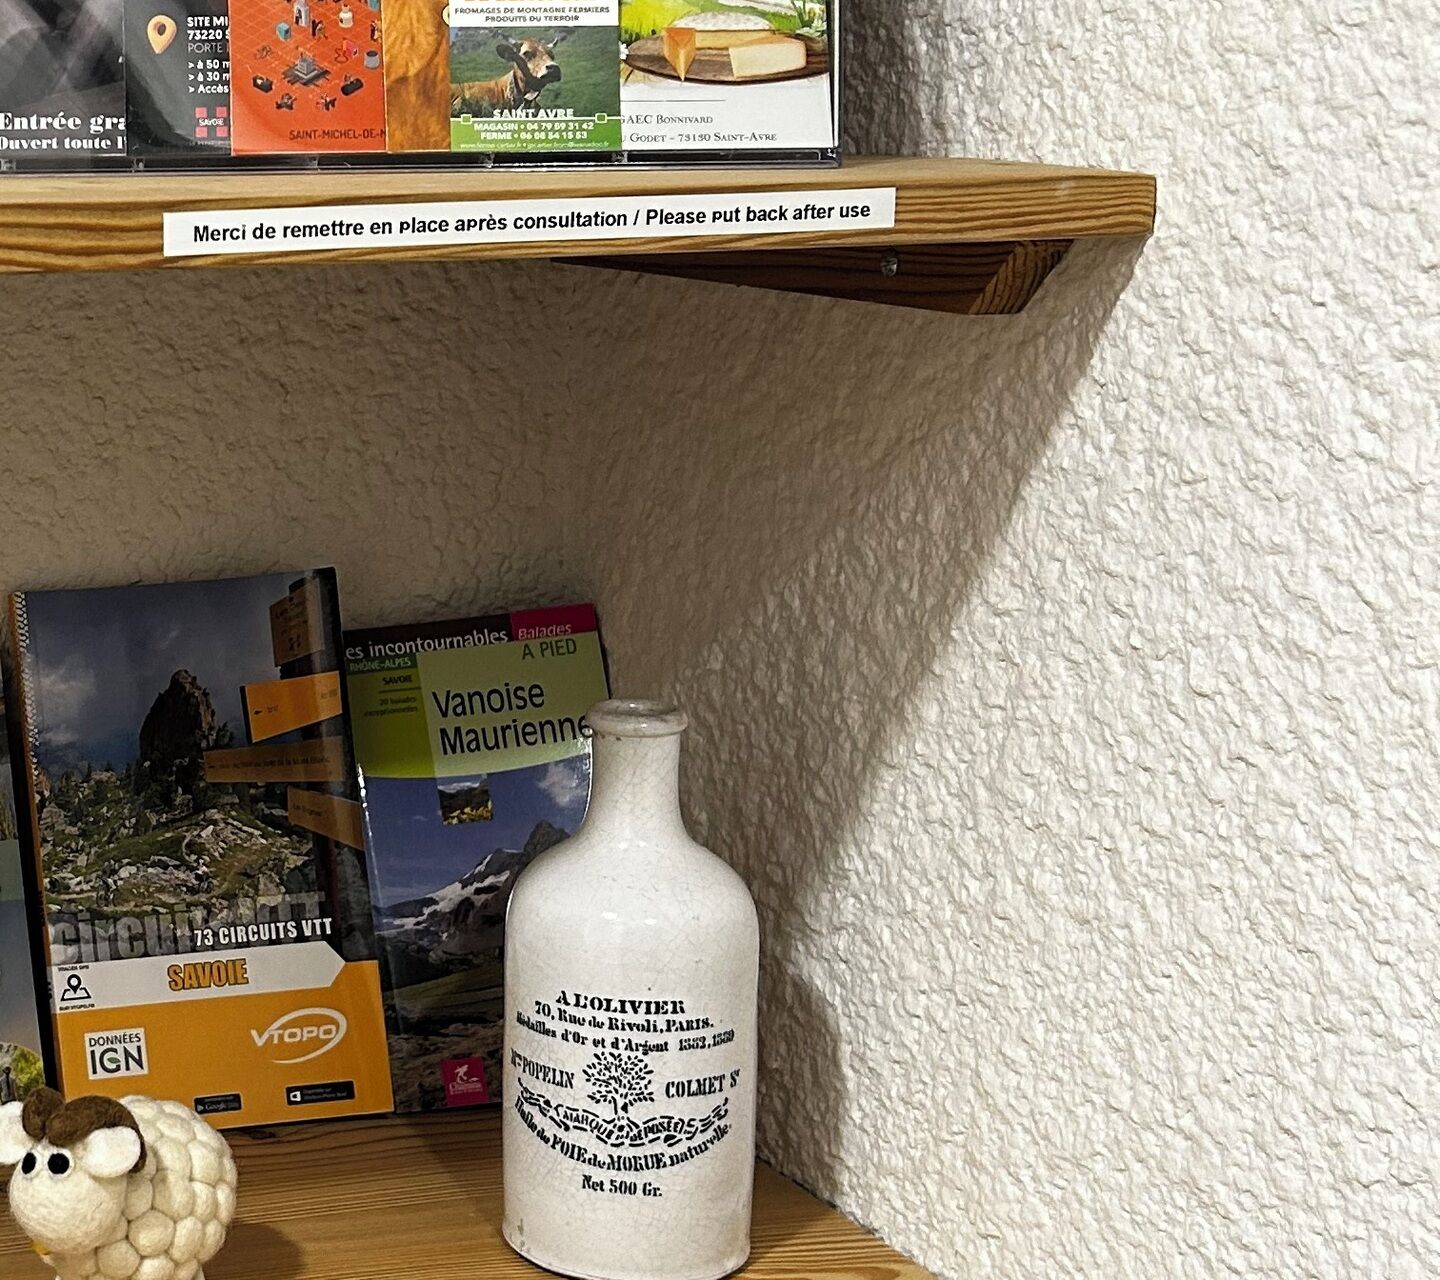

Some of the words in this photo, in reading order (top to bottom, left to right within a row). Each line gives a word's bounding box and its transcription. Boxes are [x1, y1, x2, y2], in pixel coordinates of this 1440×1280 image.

[187, 16, 210, 27] SITE
[454, 7, 501, 15] FROMAGES
[485, 15, 527, 23] PRODUITS
[187, 30, 222, 40] 73220
[187, 43, 223, 54] PORTE
[493, 109, 535, 119] SAINT
[537, 108, 574, 119] AVRE
[656, 114, 714, 125] BONNIVARD
[474, 122, 518, 131] MAGASIN
[64, 136, 111, 150] toute
[193, 223, 246, 243] Merci
[252, 222, 276, 240] de
[282, 218, 364, 239] remettre
[369, 220, 393, 235] en
[399, 214, 449, 234] place
[454, 213, 507, 232] après
[512, 209, 627, 230] consultation
[645, 206, 707, 226] Please
[711, 206, 741, 224] put
[745, 204, 788, 222] back
[792, 203, 835, 221] after
[839, 203, 871, 219] use
[518, 622, 572, 640] Balades
[368, 628, 508, 658] incontournables
[522, 643, 535, 660] A
[540, 638, 578, 658] PIED
[432, 682, 545, 719] Vanoise
[439, 714, 593, 756] Maurienne
[194, 927, 213, 946] 73
[218, 920, 297, 945] CIRCUITS
[301, 917, 333, 936] VTT
[167, 958, 249, 991] SAVOIE
[573, 993, 686, 1015] L'OLIVIER
[558, 1007, 586, 1026] Rue
[588, 1015, 605, 1029] de
[607, 1017, 664, 1034] Rivoli,
[666, 1017, 714, 1033] PARIS.
[88, 1031, 141, 1047] DONNÉES
[250, 1023, 337, 1046] VTOPO
[610, 1037, 669, 1055] d'Argent
[90, 1045, 144, 1075] IGN
[664, 1076, 726, 1100] COLMET
[582, 1175, 605, 1192] Net
[608, 1179, 637, 1196] 500
[642, 1181, 663, 1197] Gr.
